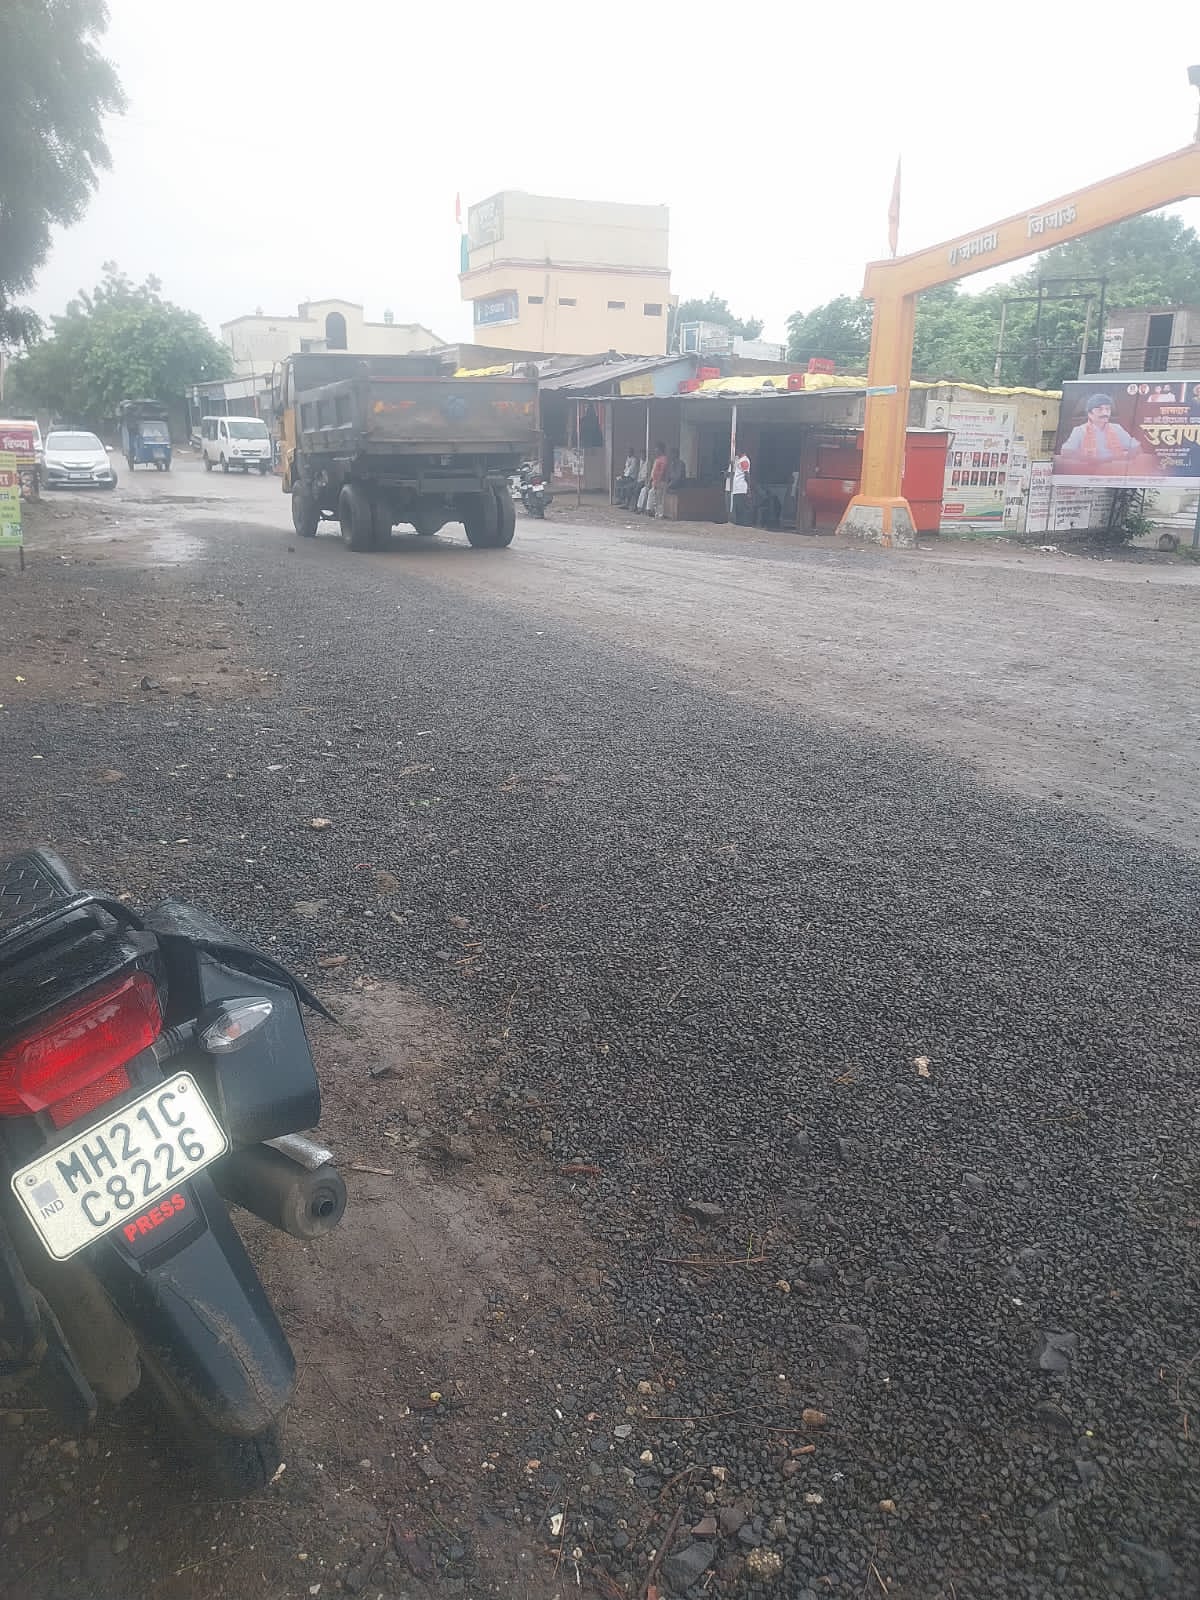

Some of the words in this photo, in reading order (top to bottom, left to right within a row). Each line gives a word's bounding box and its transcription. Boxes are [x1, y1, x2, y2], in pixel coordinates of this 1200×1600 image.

[55, 1092, 186, 1194] MH21C
[80, 1127, 205, 1227] C8226
[40, 1199, 65, 1219] IND
[123, 1193, 186, 1243] PRESS
